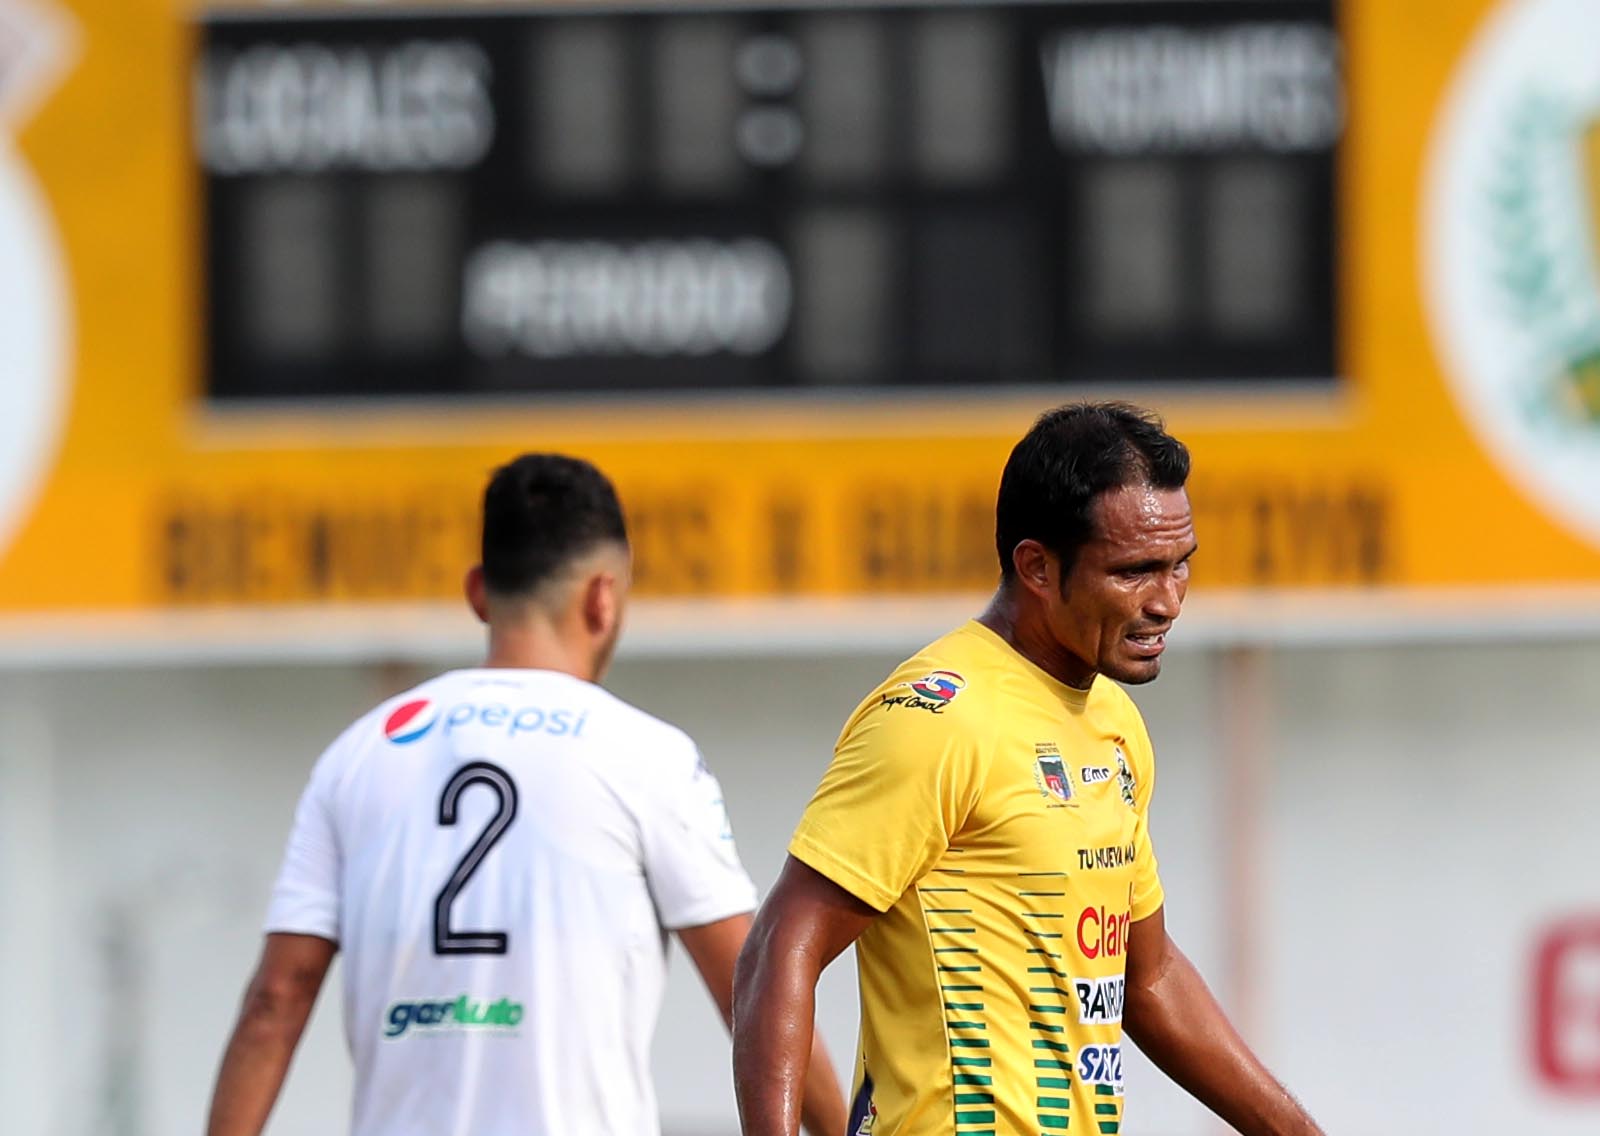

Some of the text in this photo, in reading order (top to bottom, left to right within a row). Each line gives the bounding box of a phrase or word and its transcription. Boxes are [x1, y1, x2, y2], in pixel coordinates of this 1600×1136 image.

[444, 702, 588, 738] pepsi
[433, 761, 518, 955] 2
[1077, 848, 1093, 869] TU
